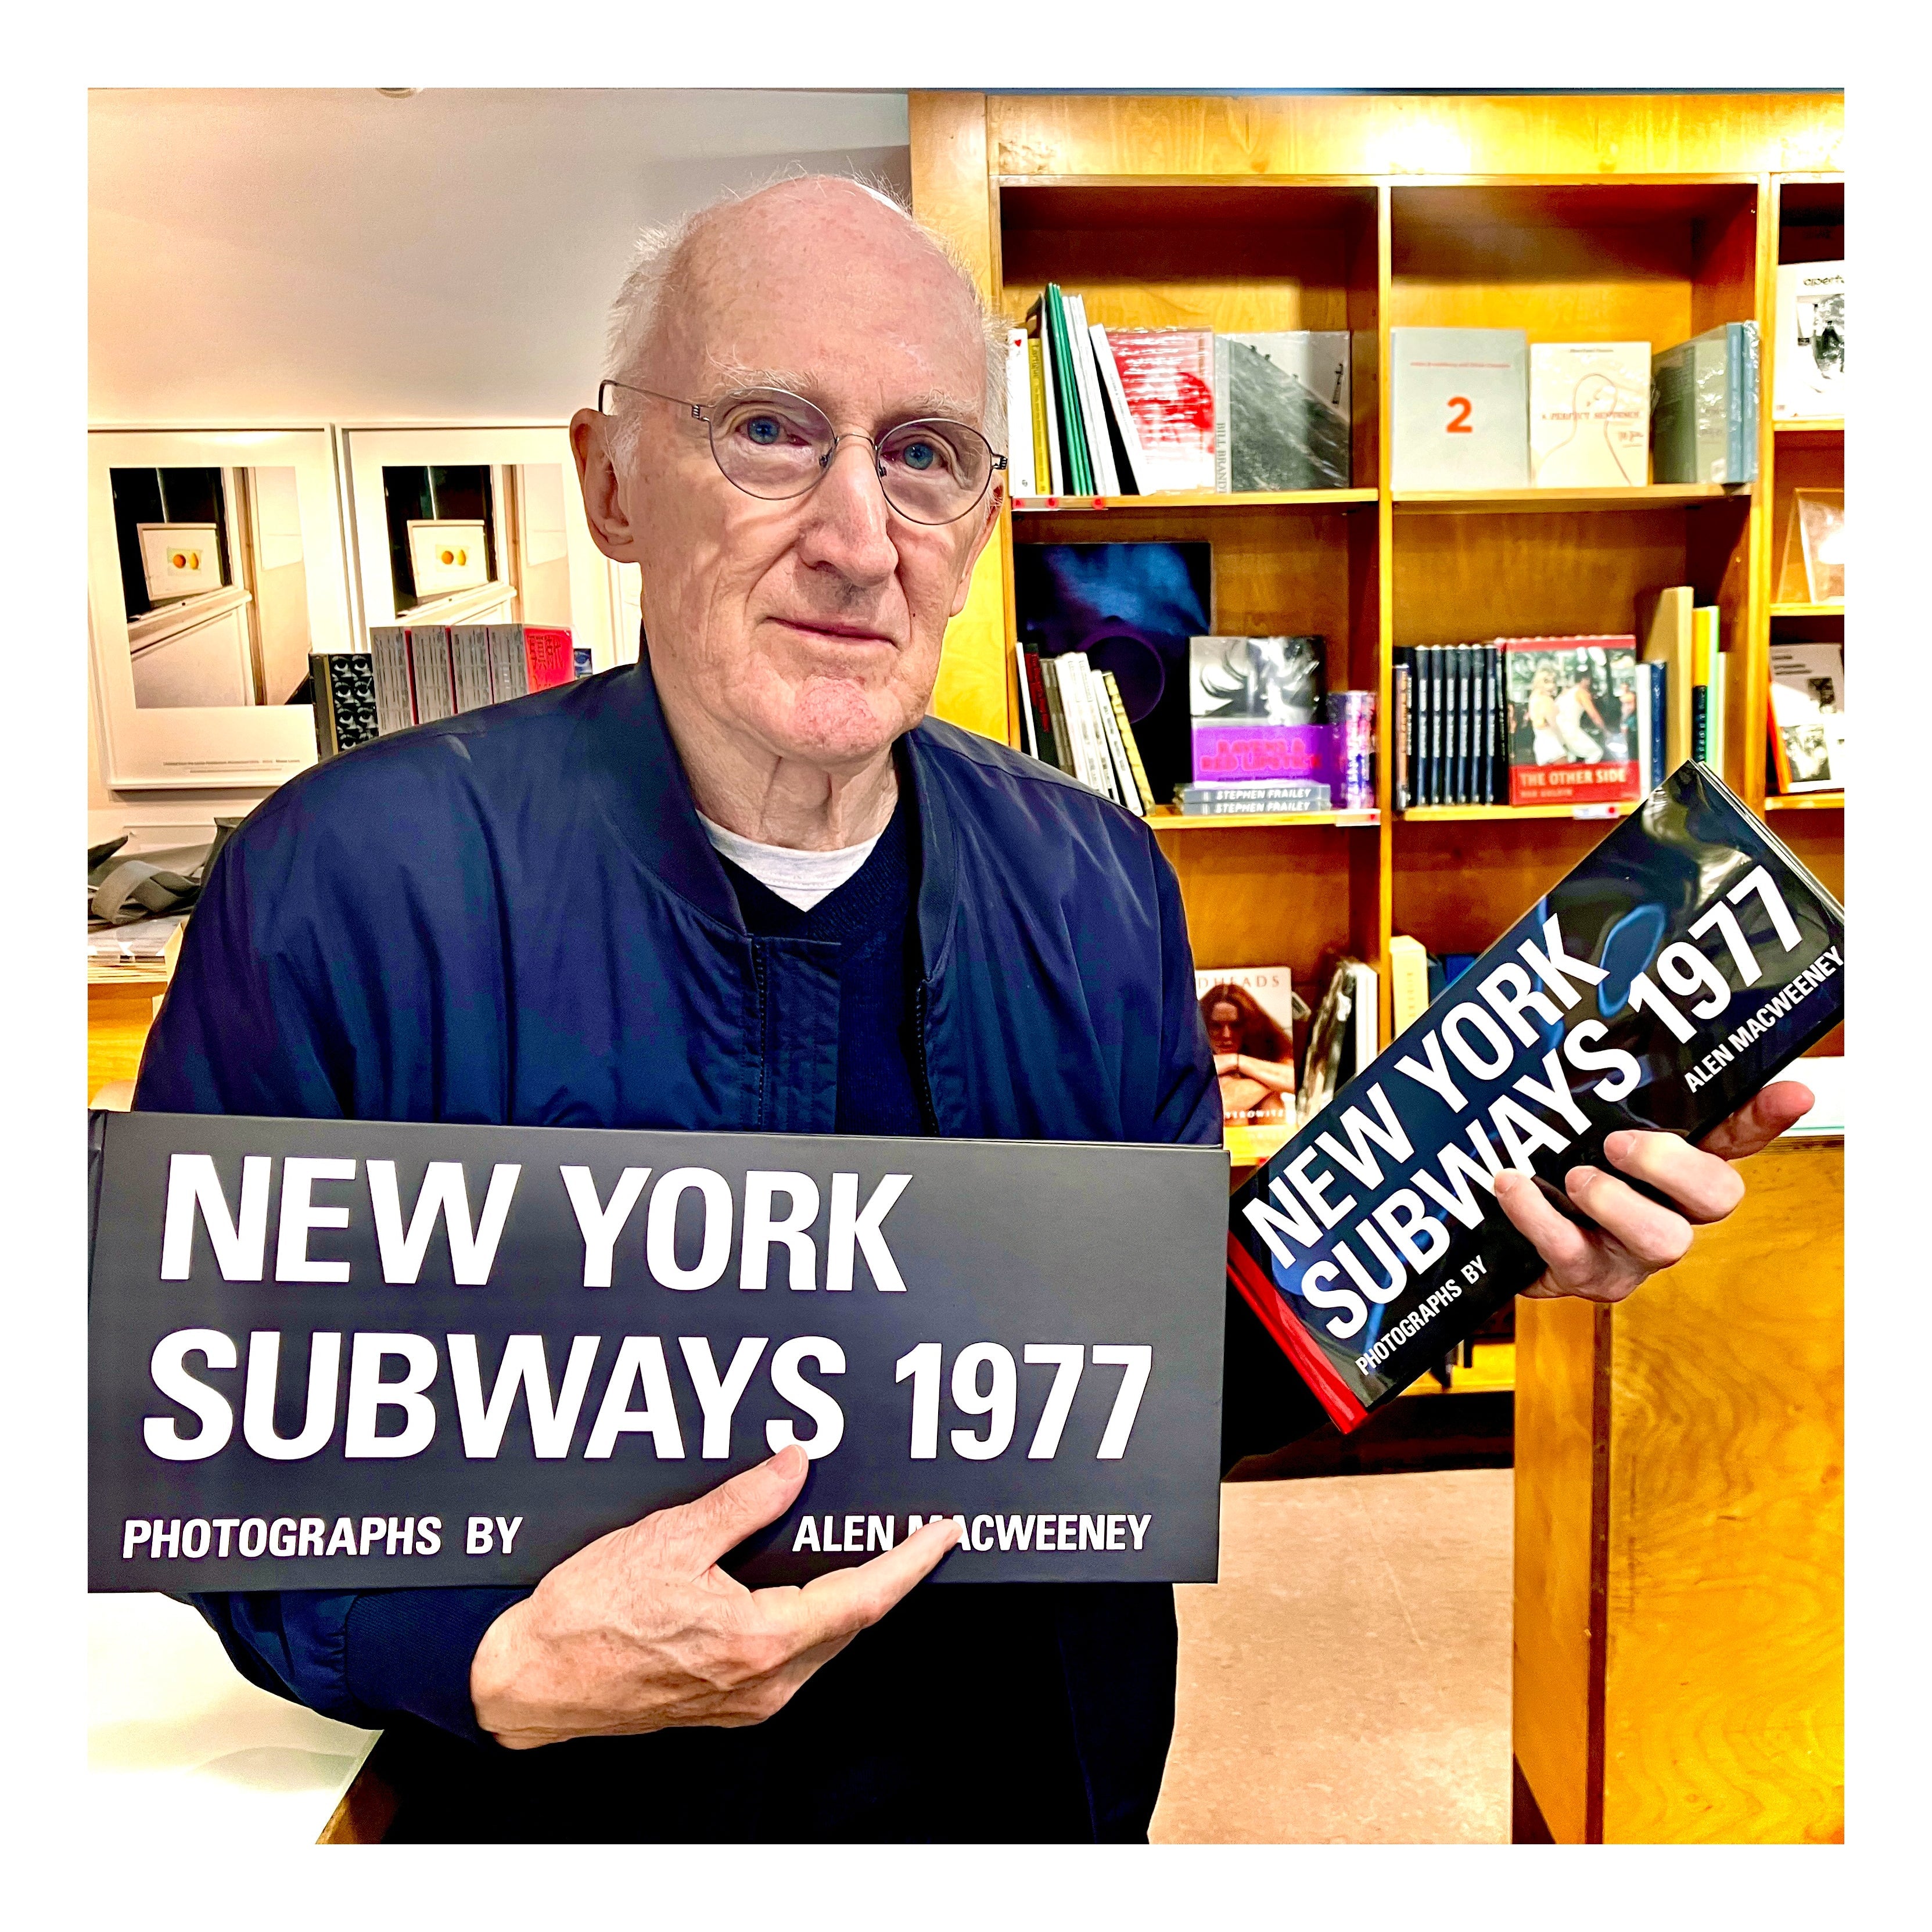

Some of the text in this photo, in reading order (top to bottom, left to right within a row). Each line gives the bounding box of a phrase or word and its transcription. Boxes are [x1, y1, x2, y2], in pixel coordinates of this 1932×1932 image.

[1803, 275, 1844, 286] apert
[1445, 396, 1474, 433] 2
[1216, 422, 1226, 448] BILL
[1216, 788, 1312, 800] STEPHEN FRAILEY
[1520, 768, 1626, 786] THE OTHER SIDE
[1216, 802, 1310, 813] STEPHEN FRAILEY
[1198, 975, 1280, 989] DHEADS
[1685, 945, 1844, 1093] ALEN MACWEENEY
[1242, 913, 1610, 1269] NEW YORK
[1301, 865, 1802, 1339] SUBWAYS 1977
[1224, 1109, 1284, 1118] YEROWITZ
[160, 1154, 914, 1292] NEW YORK
[1355, 1255, 1487, 1376] PHOTOGRAPHS BY
[143, 1328, 1152, 1461] SUBWAYS 1977
[123, 1517, 523, 1558] PHOTOGRAPHS BY
[792, 1516, 895, 1552] ALEN
